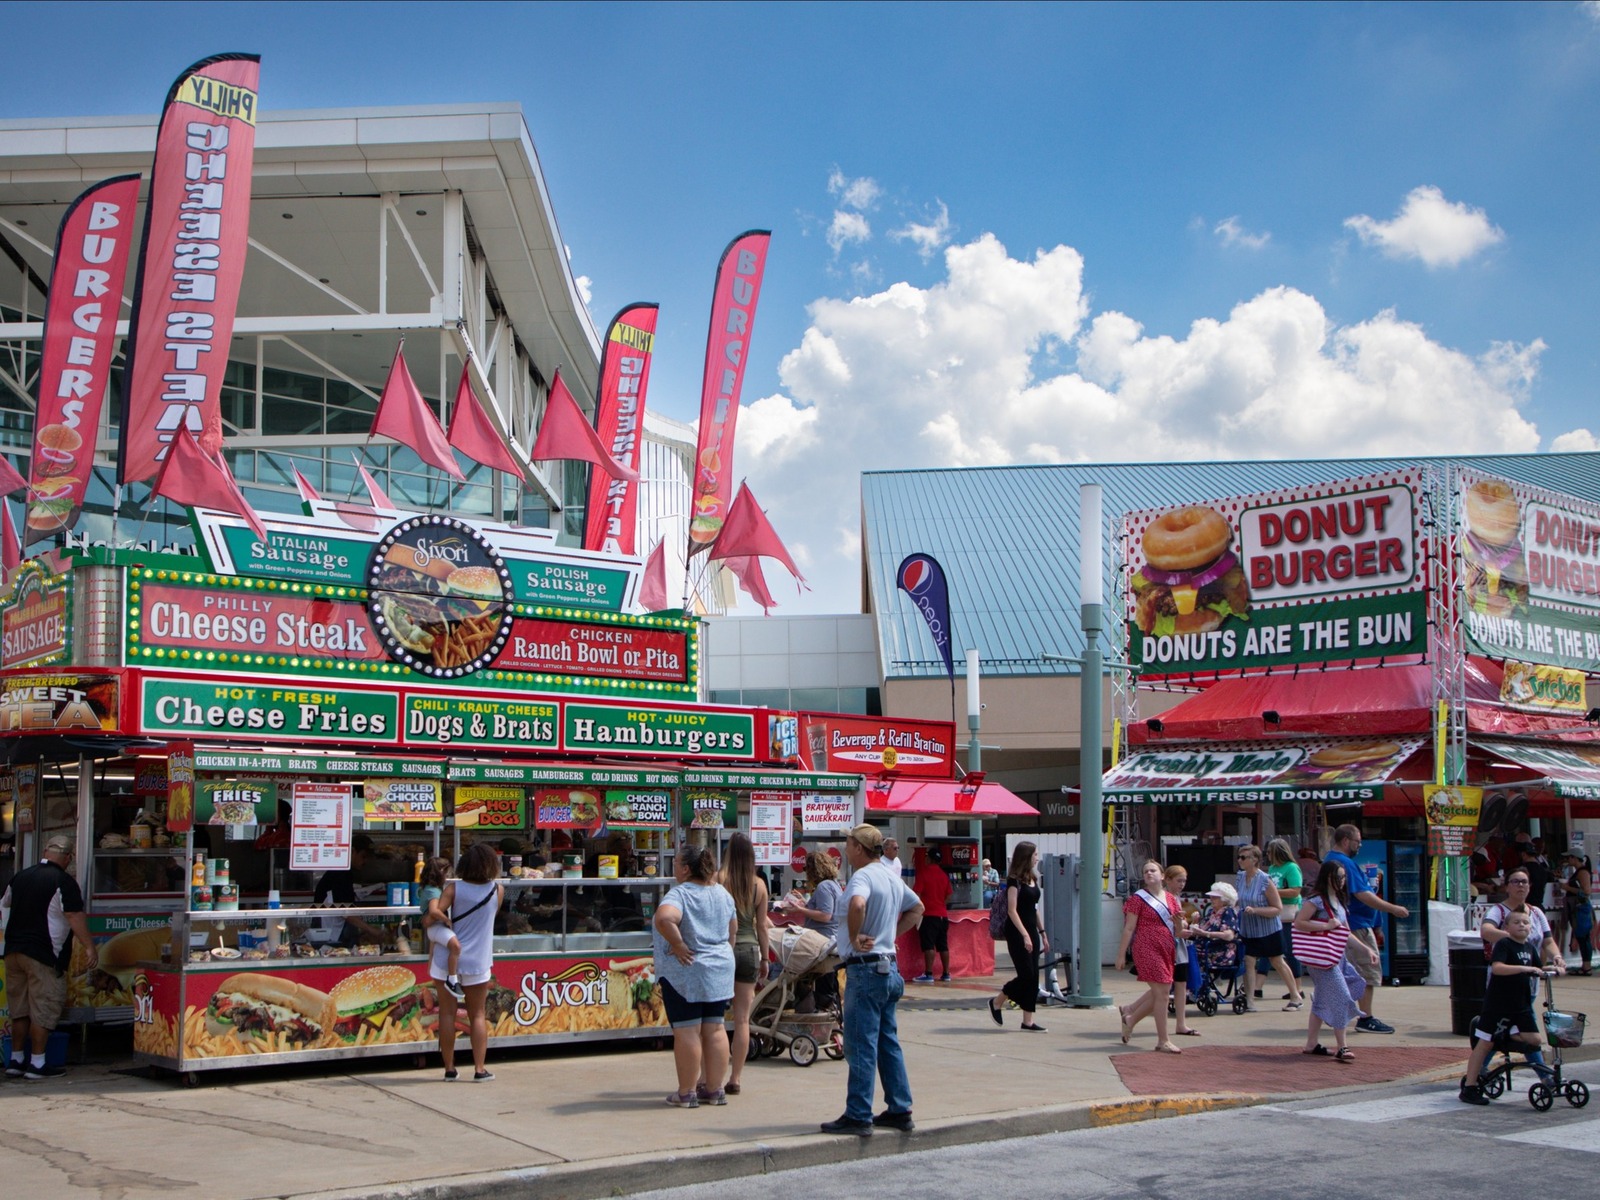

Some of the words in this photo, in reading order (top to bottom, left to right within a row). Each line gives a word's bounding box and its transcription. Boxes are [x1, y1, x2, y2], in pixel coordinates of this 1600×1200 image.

[57, 201, 121, 430] BURGERS
[1258, 494, 1391, 548] DONUT
[271, 535, 329, 552] ITALIAN
[250, 540, 349, 570] Sausage
[414, 537, 470, 568] Sivori
[265, 564, 286, 573] Green
[286, 566, 314, 577] Peppers
[329, 570, 352, 579] Onions
[1250, 537, 1406, 590] BURGER
[545, 566, 589, 581] POLISH
[527, 571, 608, 597] Sausage
[203, 595, 273, 613] PHILLY
[539, 592, 556, 600] Green
[556, 594, 579, 603] Peppers
[591, 597, 610, 605] Onions
[150, 601, 267, 645] Cheese
[276, 611, 368, 651] Steak
[917, 596, 948, 647] pepsi
[5, 614, 63, 659] SAUSAGE
[570, 628, 633, 644] CHICKEN
[1142, 629, 1237, 664] DONUTS
[1242, 624, 1292, 656] ARE
[1298, 618, 1350, 651] THE
[1357, 611, 1413, 646] BUN
[1468, 610, 1524, 650] DONUTS
[1526, 622, 1555, 654] ARE
[1554, 627, 1585, 659] THE
[514, 636, 572, 662] Ranch
[577, 641, 619, 665] Bowl
[623, 650, 641, 667] or
[645, 647, 680, 670] Pita
[215, 687, 256, 701] HOT
[272, 691, 337, 705] FRESH
[1528, 674, 1581, 703] Totchos
[0, 687, 87, 707] SWEET
[155, 695, 286, 731] Cheese
[297, 702, 387, 735] Fries
[413, 699, 449, 712] CHILI
[457, 701, 500, 715] KRAUT
[506, 703, 554, 717] CHEESE
[409, 710, 463, 742] Dogs
[469, 713, 490, 738] &
[492, 714, 554, 742] Brats
[627, 711, 656, 723] HOT
[664, 713, 708, 726] JUICY
[573, 718, 746, 752] Hamburgers
[832, 729, 877, 751] Beverage
[878, 728, 886, 746] &
[888, 729, 912, 748] Refill
[913, 731, 946, 754] Station
[195, 756, 237, 767] CHICKEN
[238, 757, 282, 769] IN-A-PITA
[288, 759, 318, 770] BRATS
[326, 760, 360, 771] CHEESE
[361, 762, 394, 773] STEAKS
[402, 763, 443, 775] SAUSAGES
[1125, 753, 1223, 778] Freshly
[1219, 751, 1291, 774] Made
[449, 767, 477, 778] BRATS
[484, 768, 525, 779] SAUSAGES
[532, 770, 585, 781] HAMBURGERS
[591, 772, 611, 782] COLD
[611, 773, 639, 783] DRINKS
[645, 774, 660, 783] HOT
[661, 775, 679, 784] DOGS
[684, 773, 700, 783] COLD
[700, 774, 724, 784] DRINKS
[727, 775, 740, 784] HOT
[740, 775, 756, 785] DOGS
[759, 776, 785, 786] CHICKEN
[785, 777, 812, 787] IN-A-PITA
[816, 778, 838, 787] CHEESE
[838, 779, 860, 788] STEAKS
[1109, 775, 1182, 788] NEVER
[1181, 775, 1271, 788] FROZEN
[203, 782, 235, 793] Philly
[236, 782, 270, 793] Cheese
[314, 785, 333, 793] Menu
[389, 783, 435, 793] GRILLED
[460, 789, 484, 798] CHILI
[486, 789, 521, 799] CHEESE
[1560, 785, 1592, 799] MADE
[213, 790, 262, 804] FRIES
[386, 792, 435, 802] CHICKEN
[626, 794, 667, 803] CHICKEN
[1149, 792, 1201, 804] WITH
[1206, 790, 1275, 802] FRESH
[1280, 788, 1374, 801] DONUTS
[410, 802, 435, 811] PITA
[485, 800, 519, 812] HOT
[632, 803, 667, 812] RANCH
[693, 799, 727, 810] FRIES
[805, 803, 851, 812] BRATWURST
[1046, 802, 1075, 817] Wing
[1439, 806, 1479, 816] Totchos
[479, 812, 521, 825] DOGS
[538, 805, 572, 823] BURGER
[638, 811, 667, 820] BOWL
[804, 814, 853, 823] SAUERKRAUT
[105, 917, 133, 931] Philly
[134, 917, 166, 929] Cheese
[514, 970, 610, 1027] Sivori
